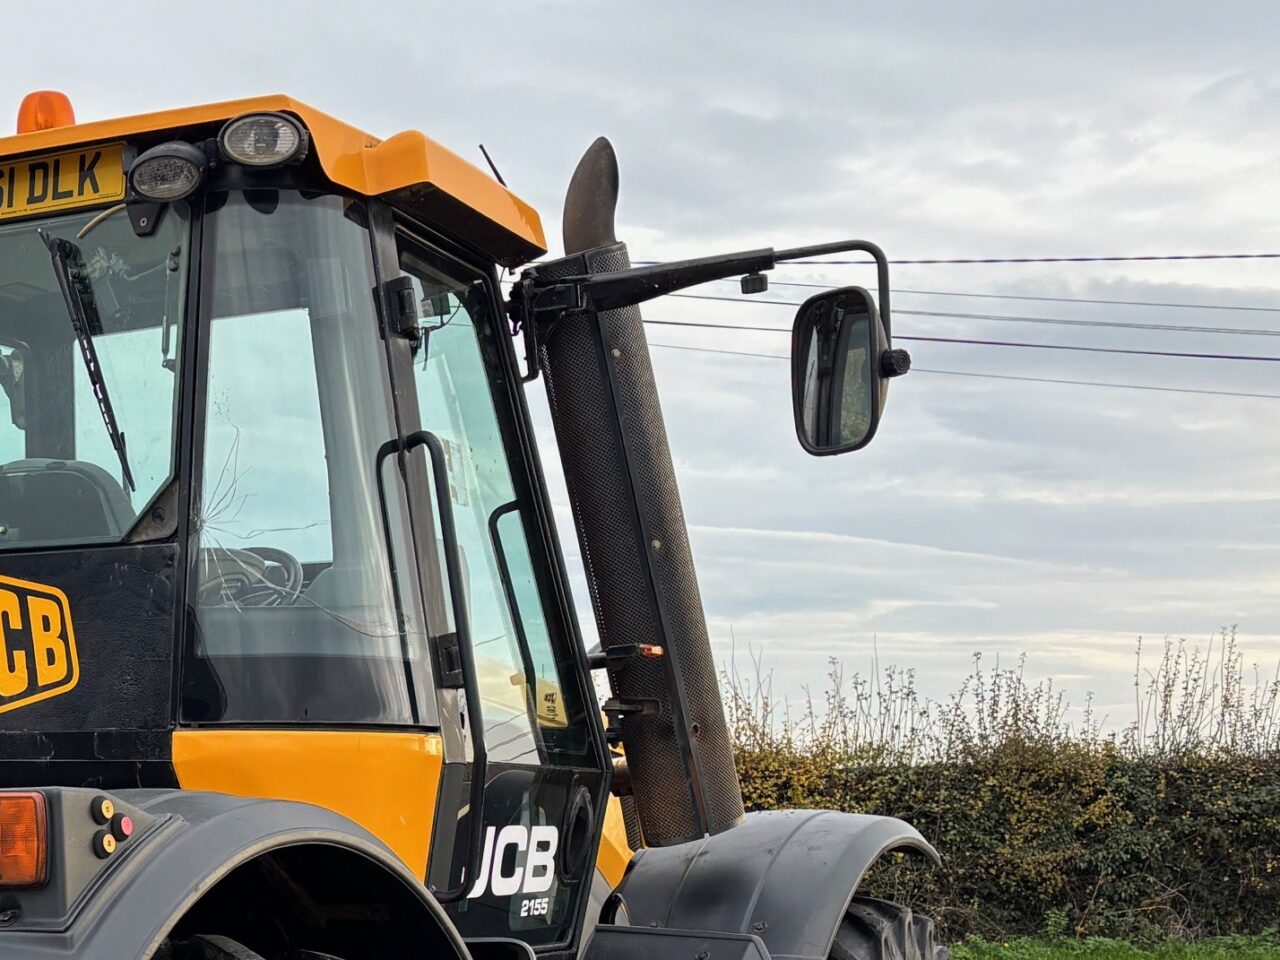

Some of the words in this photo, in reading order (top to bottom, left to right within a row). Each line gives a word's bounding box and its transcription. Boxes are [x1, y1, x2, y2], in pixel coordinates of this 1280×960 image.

[26, 150, 102, 205] DLK
[460, 824, 559, 899] JCB
[520, 896, 550, 918] 2155
